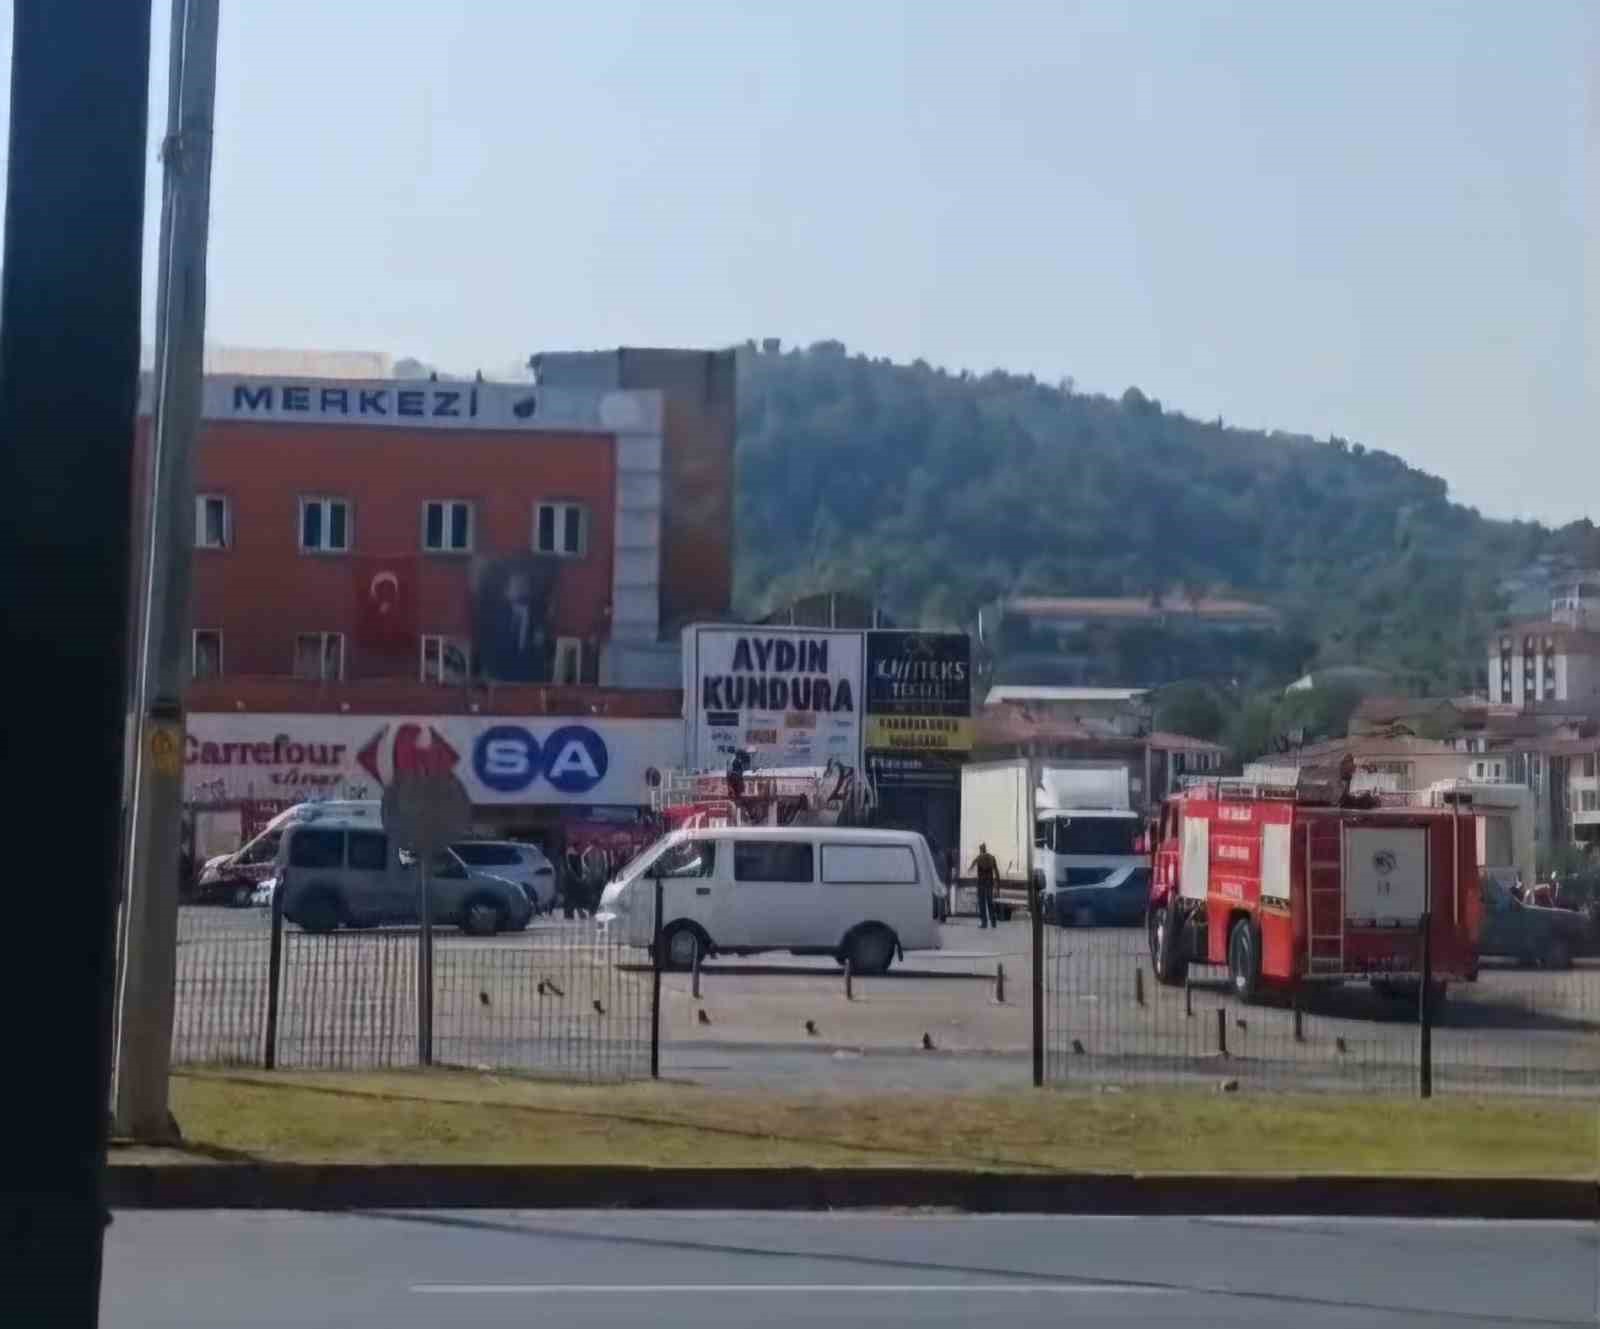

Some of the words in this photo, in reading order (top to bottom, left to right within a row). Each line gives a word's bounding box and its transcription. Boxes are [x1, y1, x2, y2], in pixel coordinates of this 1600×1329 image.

[731, 636, 829, 674] AYDIN
[703, 674, 854, 713] KUNDURA
[184, 733, 346, 766] Carrefour
